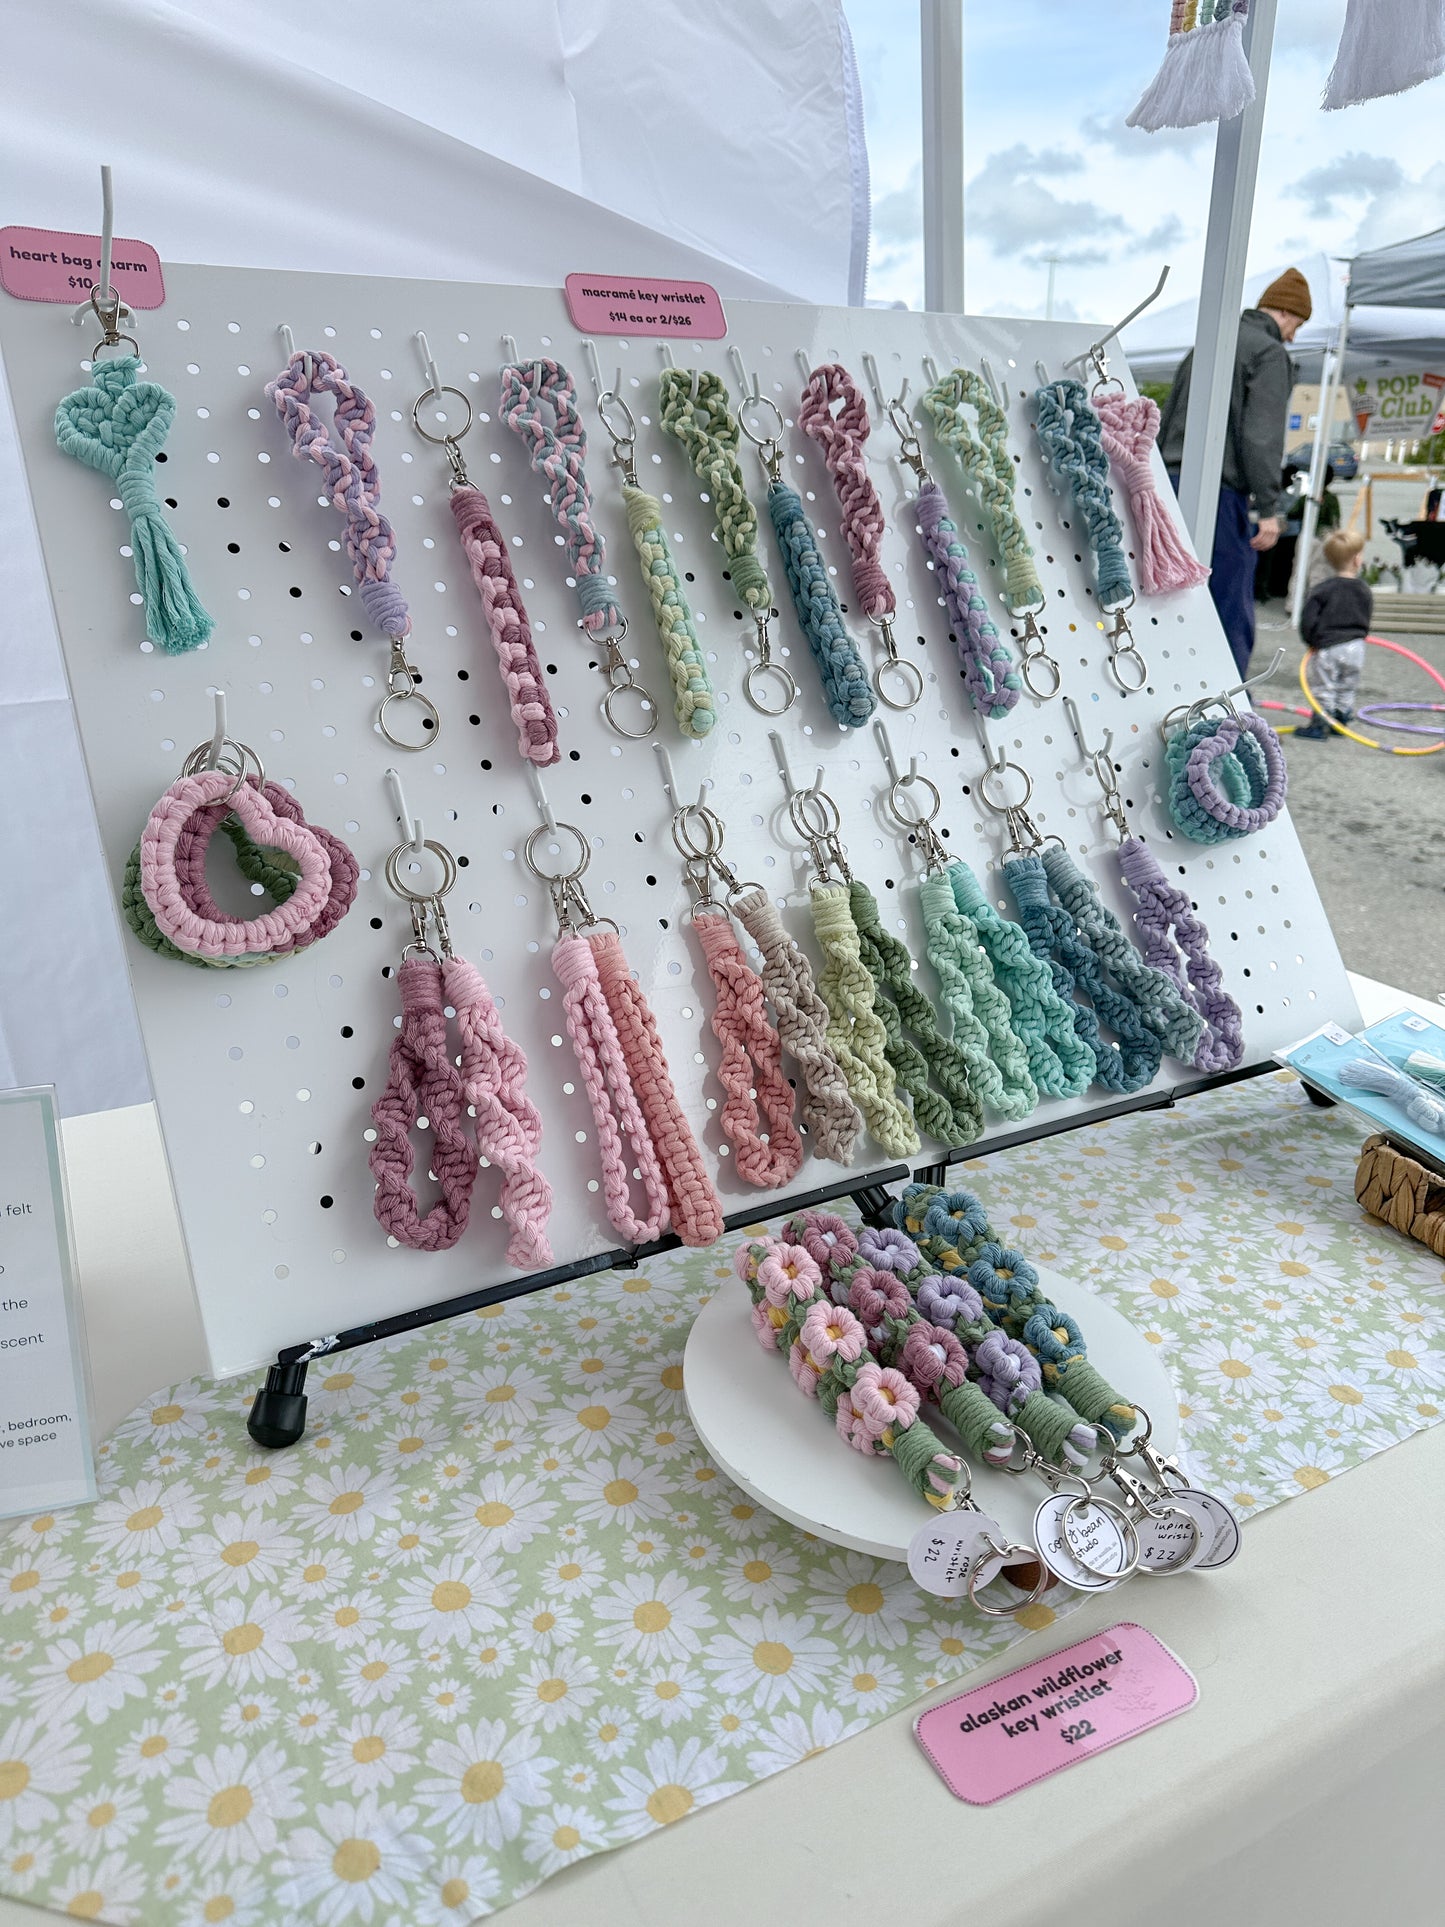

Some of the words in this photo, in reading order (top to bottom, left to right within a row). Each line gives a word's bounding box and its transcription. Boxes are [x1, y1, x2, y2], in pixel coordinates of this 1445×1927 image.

[9, 246, 58, 264] heart
[61, 252, 93, 270] bag
[96, 258, 148, 273] carm
[68, 275, 94, 289] $10
[582, 287, 636, 300] macramé
[638, 289, 658, 303] key
[661, 292, 706, 304] wristlet
[609, 311, 627, 322] $14
[630, 314, 644, 323] ea
[646, 314, 658, 323] or
[659, 313, 692, 326] 2/$26
[1376, 374, 1420, 397] POP
[1381, 394, 1433, 419] Club
[6, 1203, 33, 1216] felt
[2, 1299, 28, 1311] the
[0, 1333, 45, 1349] scent
[8, 1413, 72, 1432] bedroom,
[17, 1432, 57, 1446] space
[1076, 1516, 1105, 1543] bean
[1154, 1522, 1191, 1530] lupine
[945, 1539, 964, 1583] wristlet
[1075, 1538, 1106, 1565] studio
[958, 1556, 970, 1578] rose
[959, 1692, 1033, 1734] alaskan
[1032, 1648, 1124, 1699] wildflower
[1001, 1713, 1040, 1738] key
[1040, 1678, 1112, 1720] wristlet
[1060, 1719, 1097, 1745] $22
